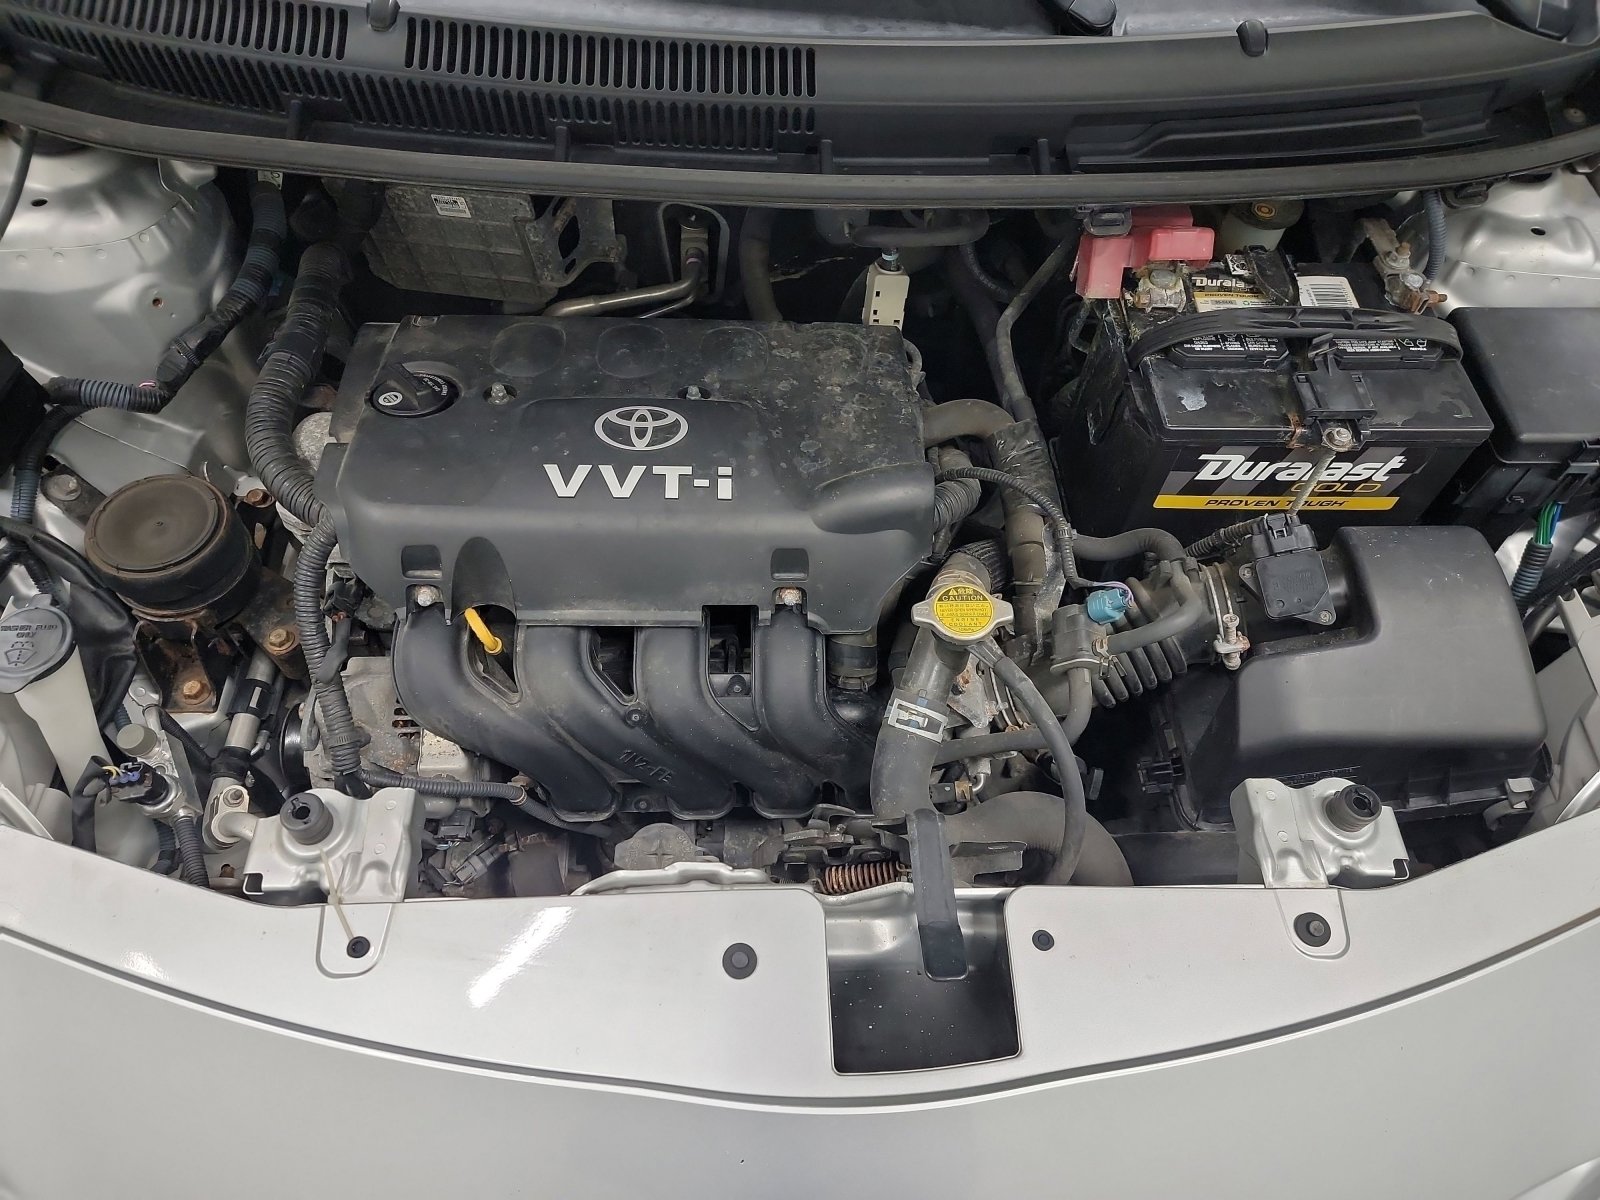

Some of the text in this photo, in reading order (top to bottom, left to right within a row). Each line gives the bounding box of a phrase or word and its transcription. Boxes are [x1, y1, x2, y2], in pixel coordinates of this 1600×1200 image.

[1191, 276, 1246, 288] Durala
[542, 463, 733, 500] VVT-i
[1204, 499, 1346, 508] PROVEN TUGH
